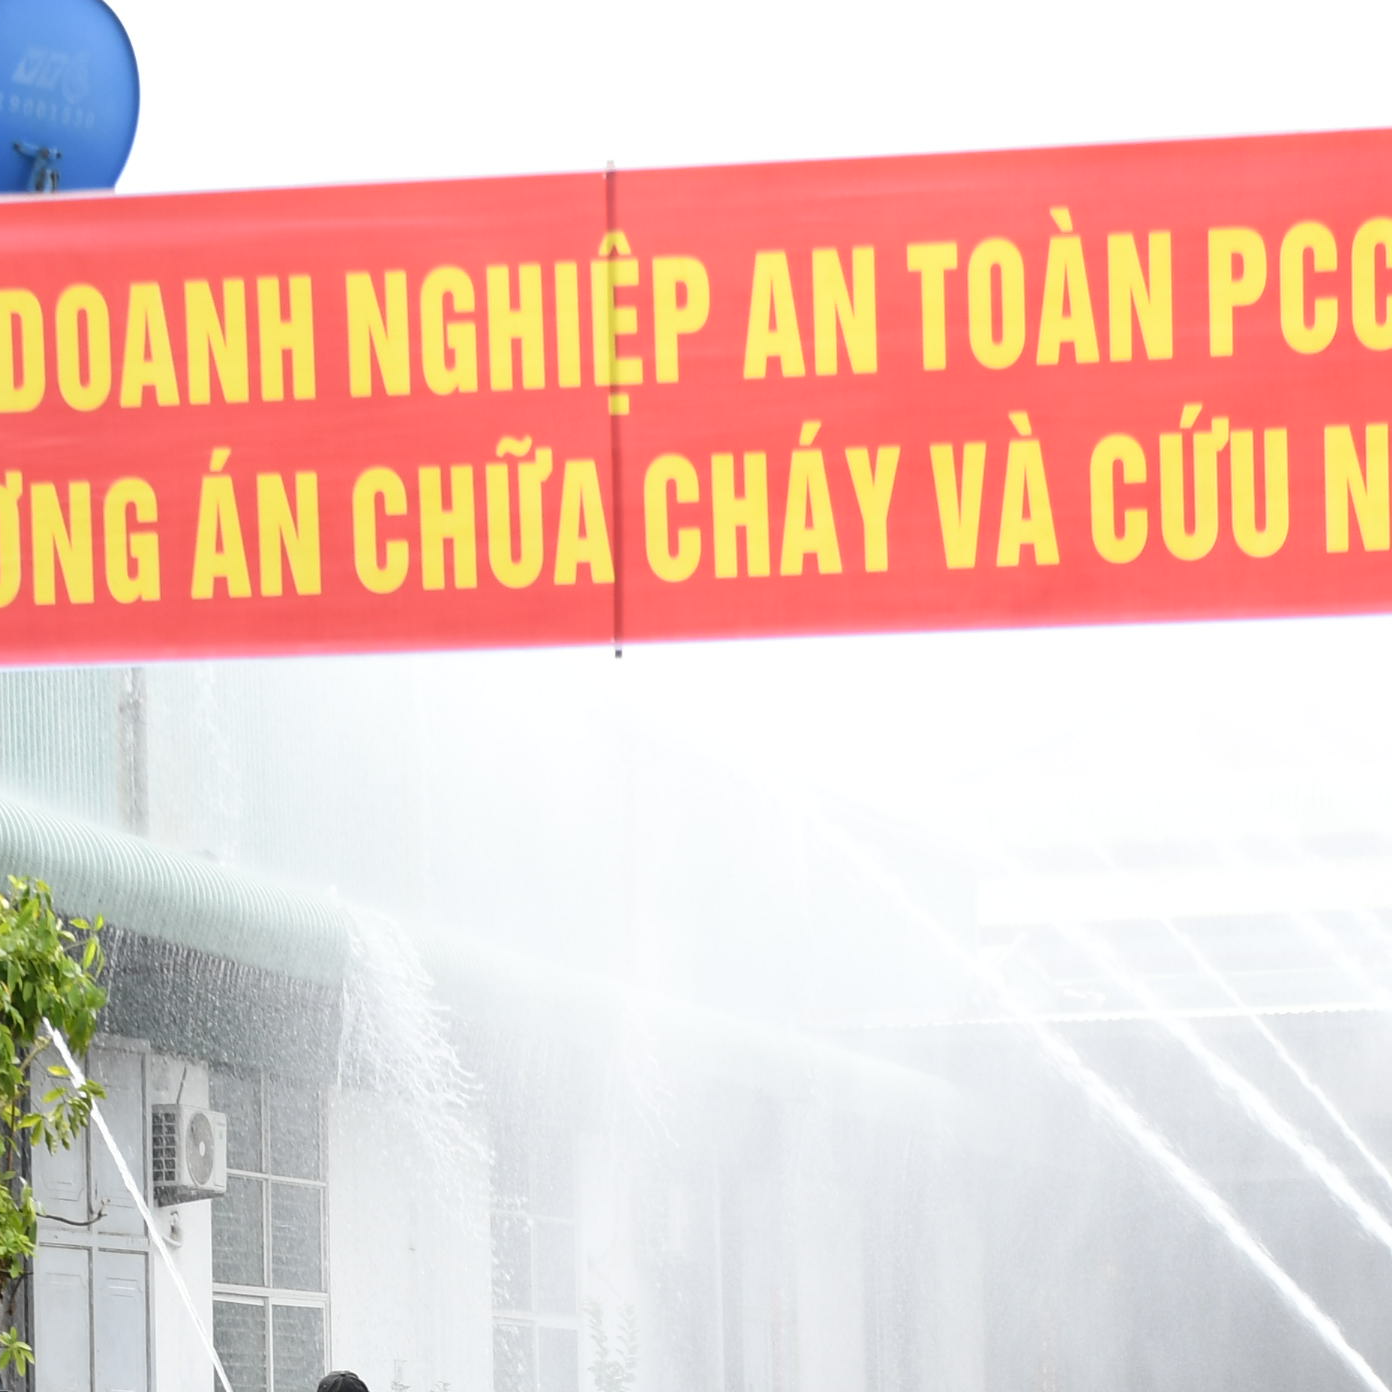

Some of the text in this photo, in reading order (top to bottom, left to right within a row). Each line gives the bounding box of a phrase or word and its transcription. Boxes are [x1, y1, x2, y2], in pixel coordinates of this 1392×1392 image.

[347, 233, 709, 413] NGHIỆP
[745, 248, 876, 377] AN
[908, 210, 1172, 368] TOÀN
[193, 450, 320, 597] ÁN
[354, 439, 613, 591] CHỮA
[645, 423, 899, 580] CHÁY
[932, 414, 1059, 567] VÀ
[1091, 405, 1288, 562] CỨU
